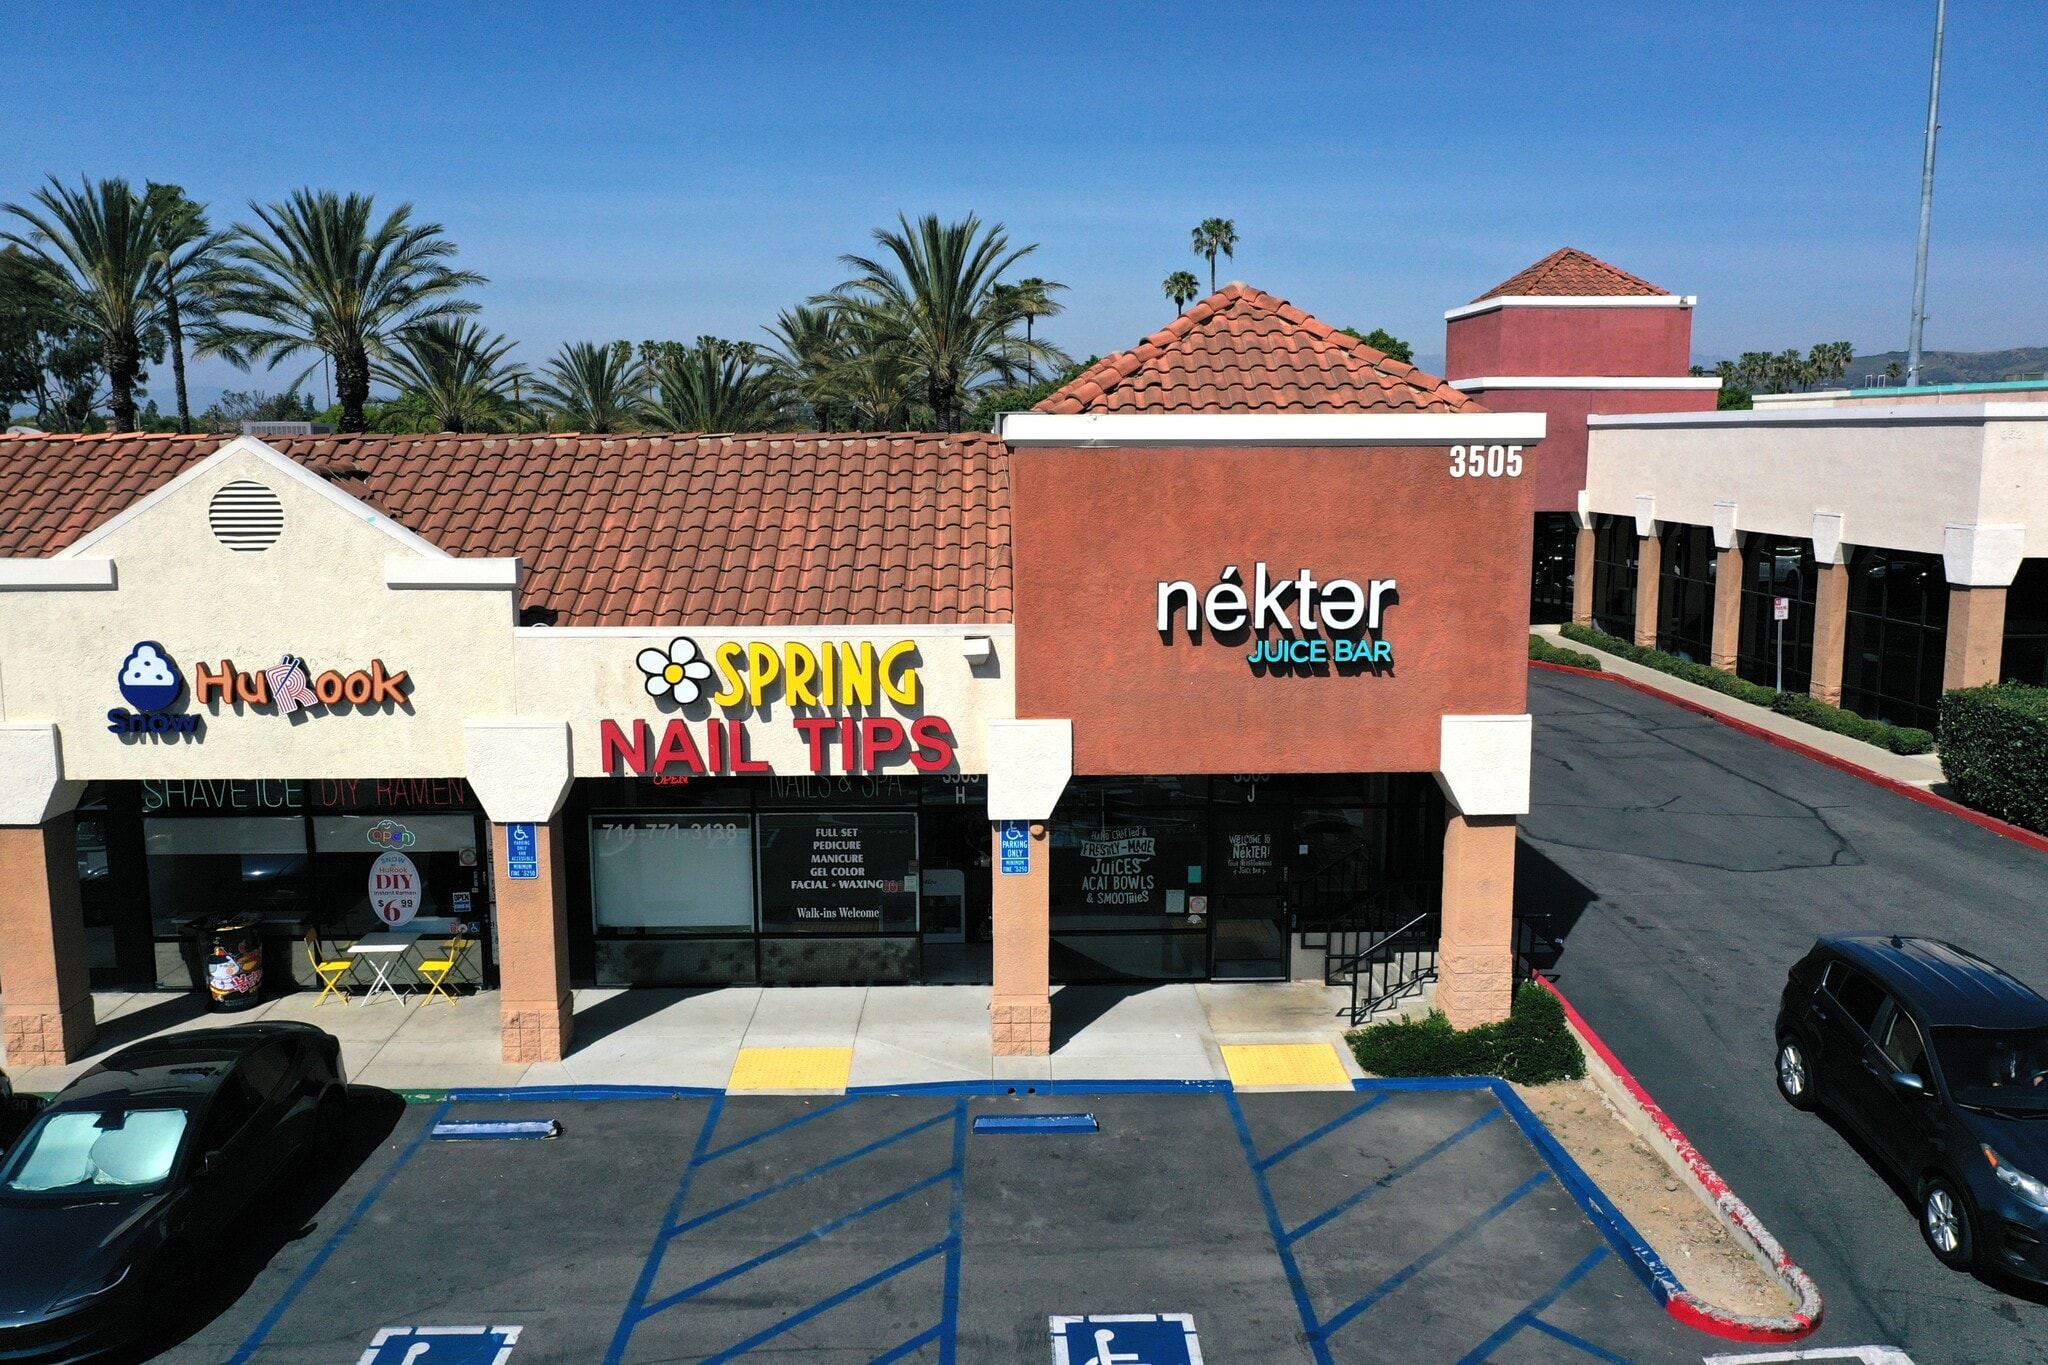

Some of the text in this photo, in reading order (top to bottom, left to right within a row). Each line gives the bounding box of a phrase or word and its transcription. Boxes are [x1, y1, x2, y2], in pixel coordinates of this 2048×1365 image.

[1449, 445, 1523, 478] 3505
[1248, 639, 1392, 663] JUICE BAR
[714, 640, 916, 707] SPRING
[196, 655, 408, 715] HuRook
[107, 707, 201, 735] Snow
[600, 716, 953, 774] NAIL TIPS
[653, 774, 689, 785] OPEN
[143, 779, 303, 808] SHAVE ICE
[320, 778, 465, 807] DIY RAMEN
[769, 776, 832, 800] NAILS
[861, 776, 903, 800] SPA
[955, 786, 966, 805] H
[1247, 784, 1255, 803] J
[815, 828, 859, 837] FULL SET
[813, 841, 862, 850] PEDICURE
[1002, 840, 1028, 849] PARKING
[811, 854, 864, 863] MANICURE
[1007, 849, 1023, 858] ONLY
[810, 867, 865, 876] GEL COLOR
[376, 874, 413, 890] DIY
[791, 880, 883, 889] FACIAL WAXING
[1082, 875, 1155, 890] ACAI BOWLS
[1086, 892, 1094, 903] &
[797, 907, 880, 918] Walk-ins Welcome
